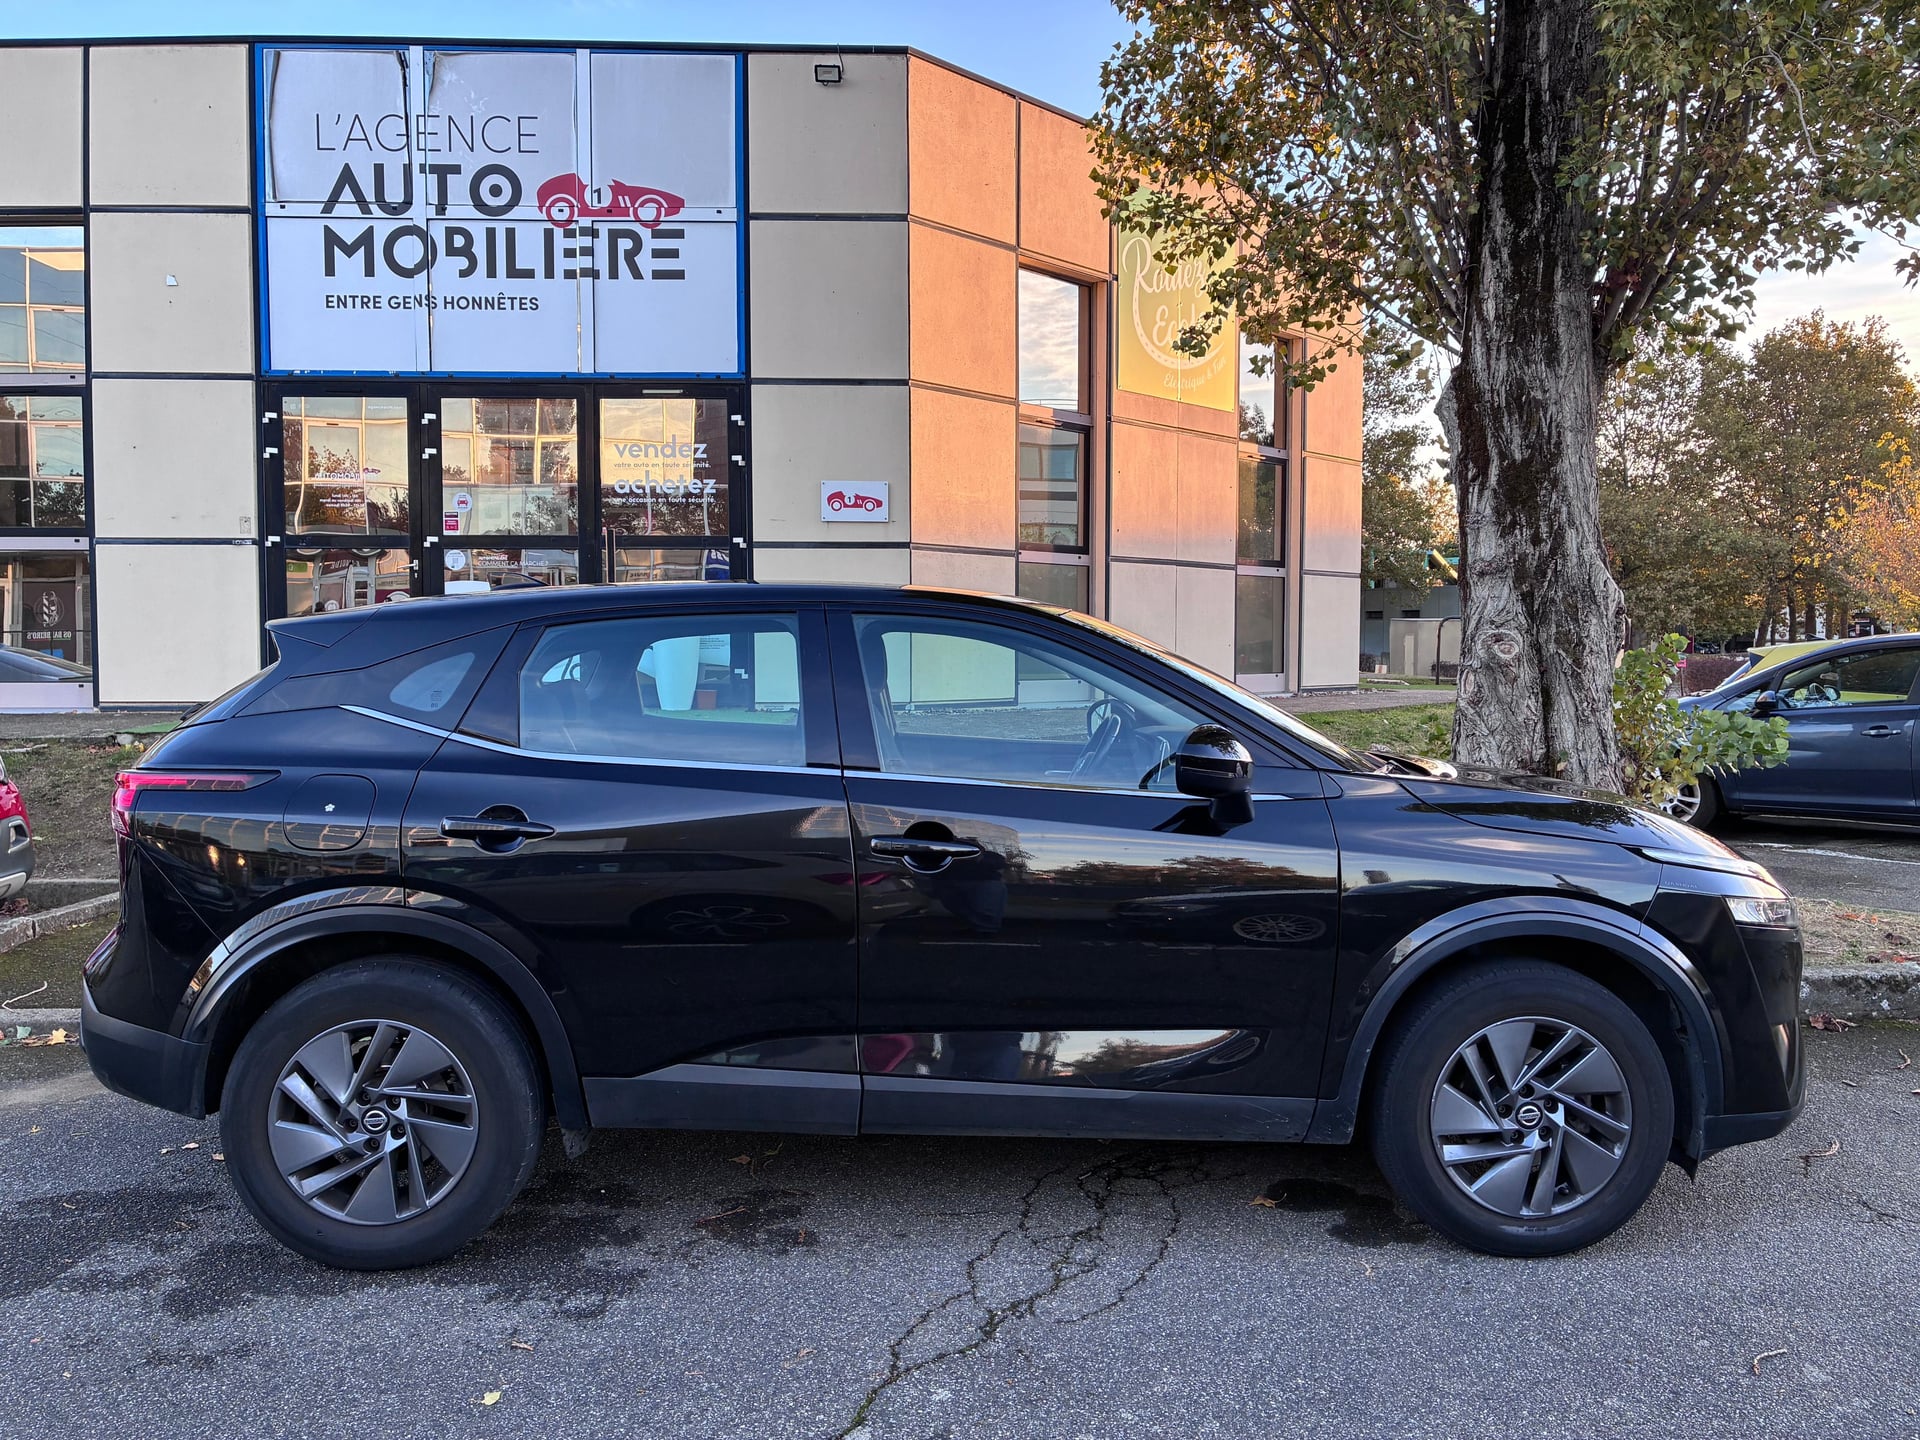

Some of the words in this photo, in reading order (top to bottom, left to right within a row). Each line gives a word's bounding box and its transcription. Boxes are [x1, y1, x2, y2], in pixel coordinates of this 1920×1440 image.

[315, 113, 540, 154] L'AGENCE
[320, 162, 523, 217] AUTO
[323, 223, 686, 280] MOBILIERE
[325, 294, 382, 310] ENTRE
[387, 292, 438, 310] GENS
[443, 291, 540, 311] HONNÊTES
[614, 434, 707, 458] vendez
[682, 460, 712, 468] séénité.
[614, 470, 717, 494] achetez
[847, 496, 853, 504] 1
